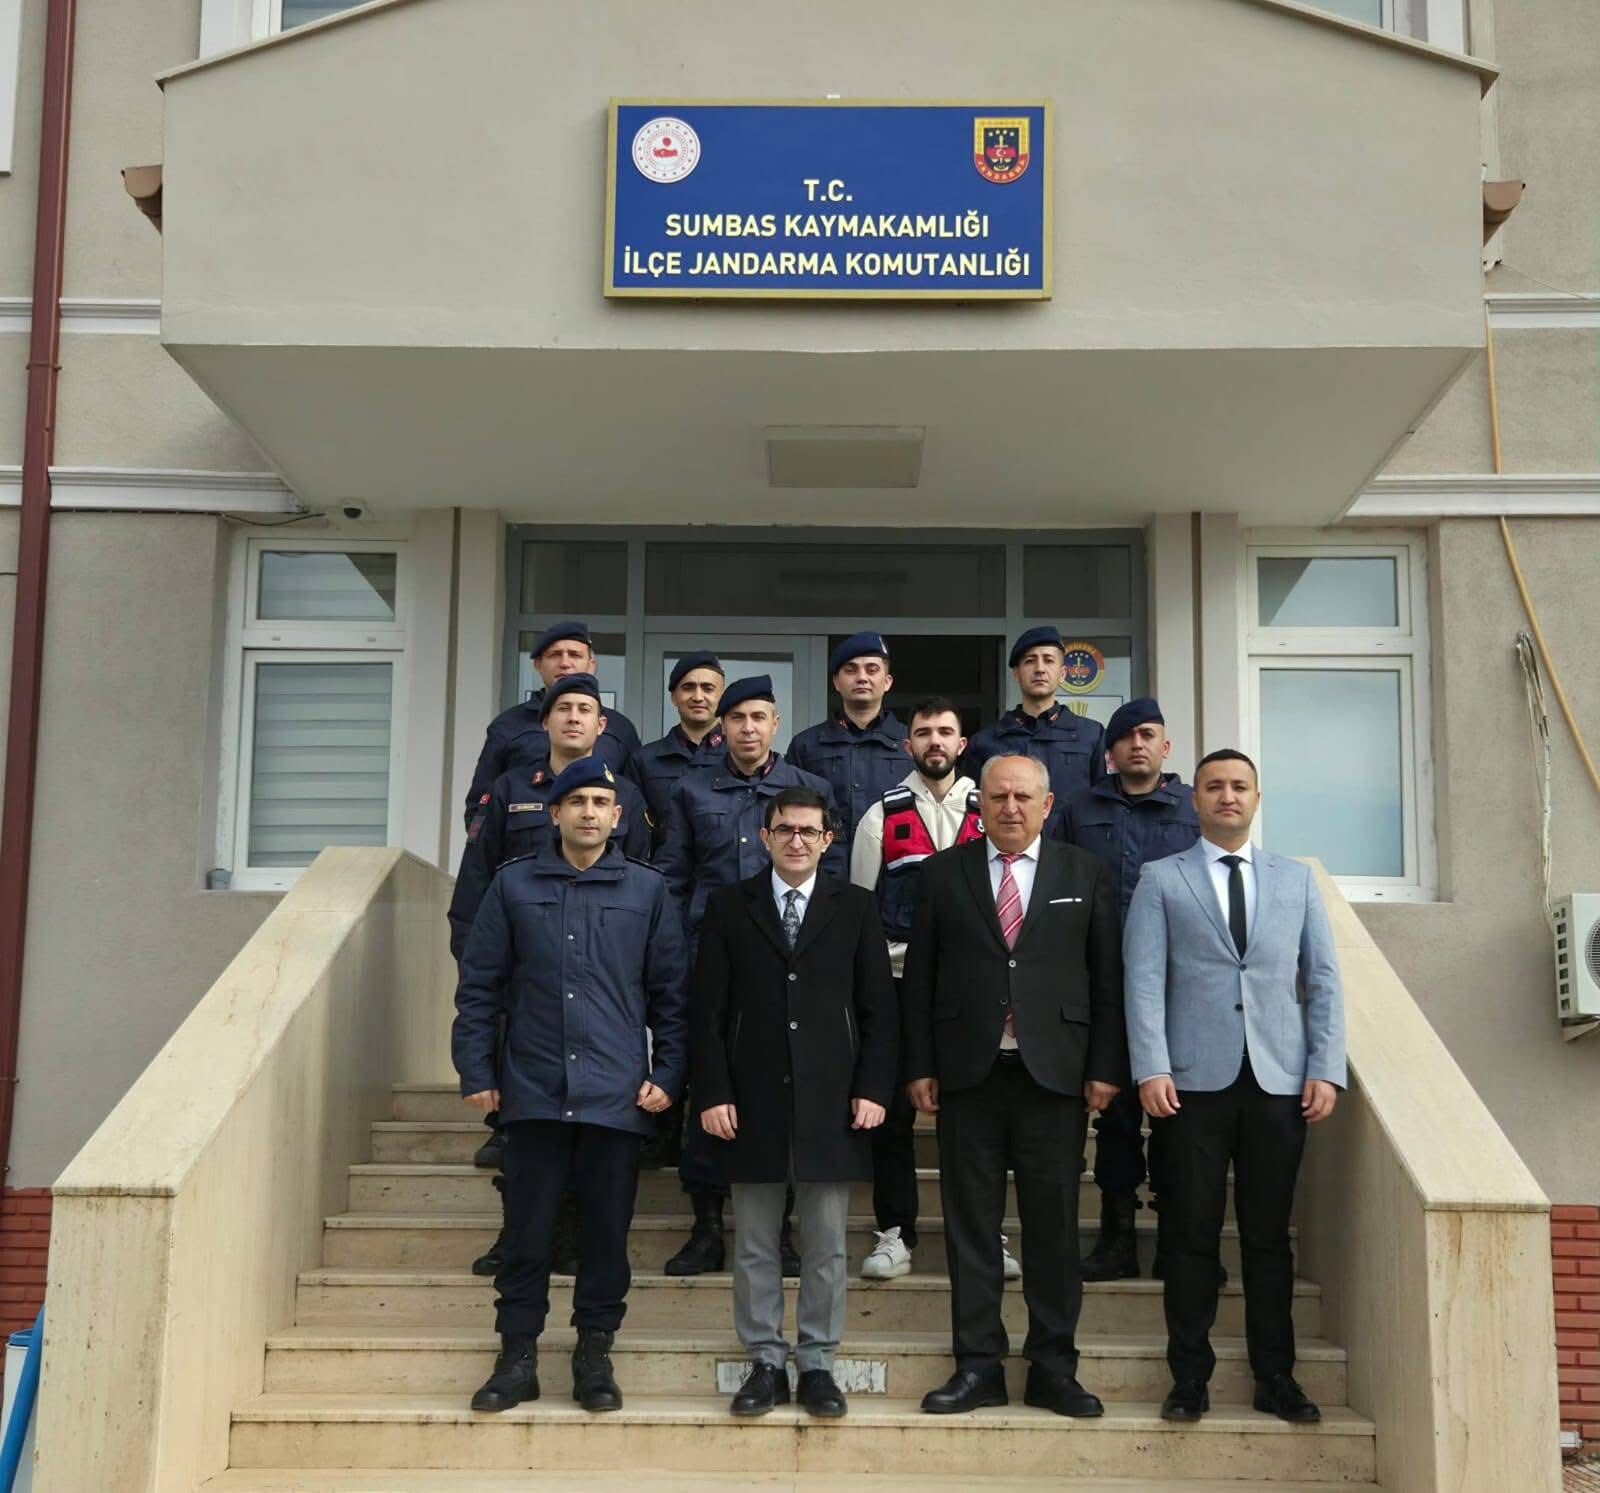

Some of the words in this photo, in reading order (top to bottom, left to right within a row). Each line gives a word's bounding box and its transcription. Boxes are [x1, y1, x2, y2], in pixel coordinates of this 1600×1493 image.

[803, 179, 853, 202] T.C.
[665, 214, 777, 237] SUMBAS
[784, 209, 989, 238] KAYMAKAMLIĞI
[624, 246, 682, 278] İLÇE
[688, 252, 838, 275] JANDARMA
[846, 247, 1030, 276] KOMUTANLIĞI
